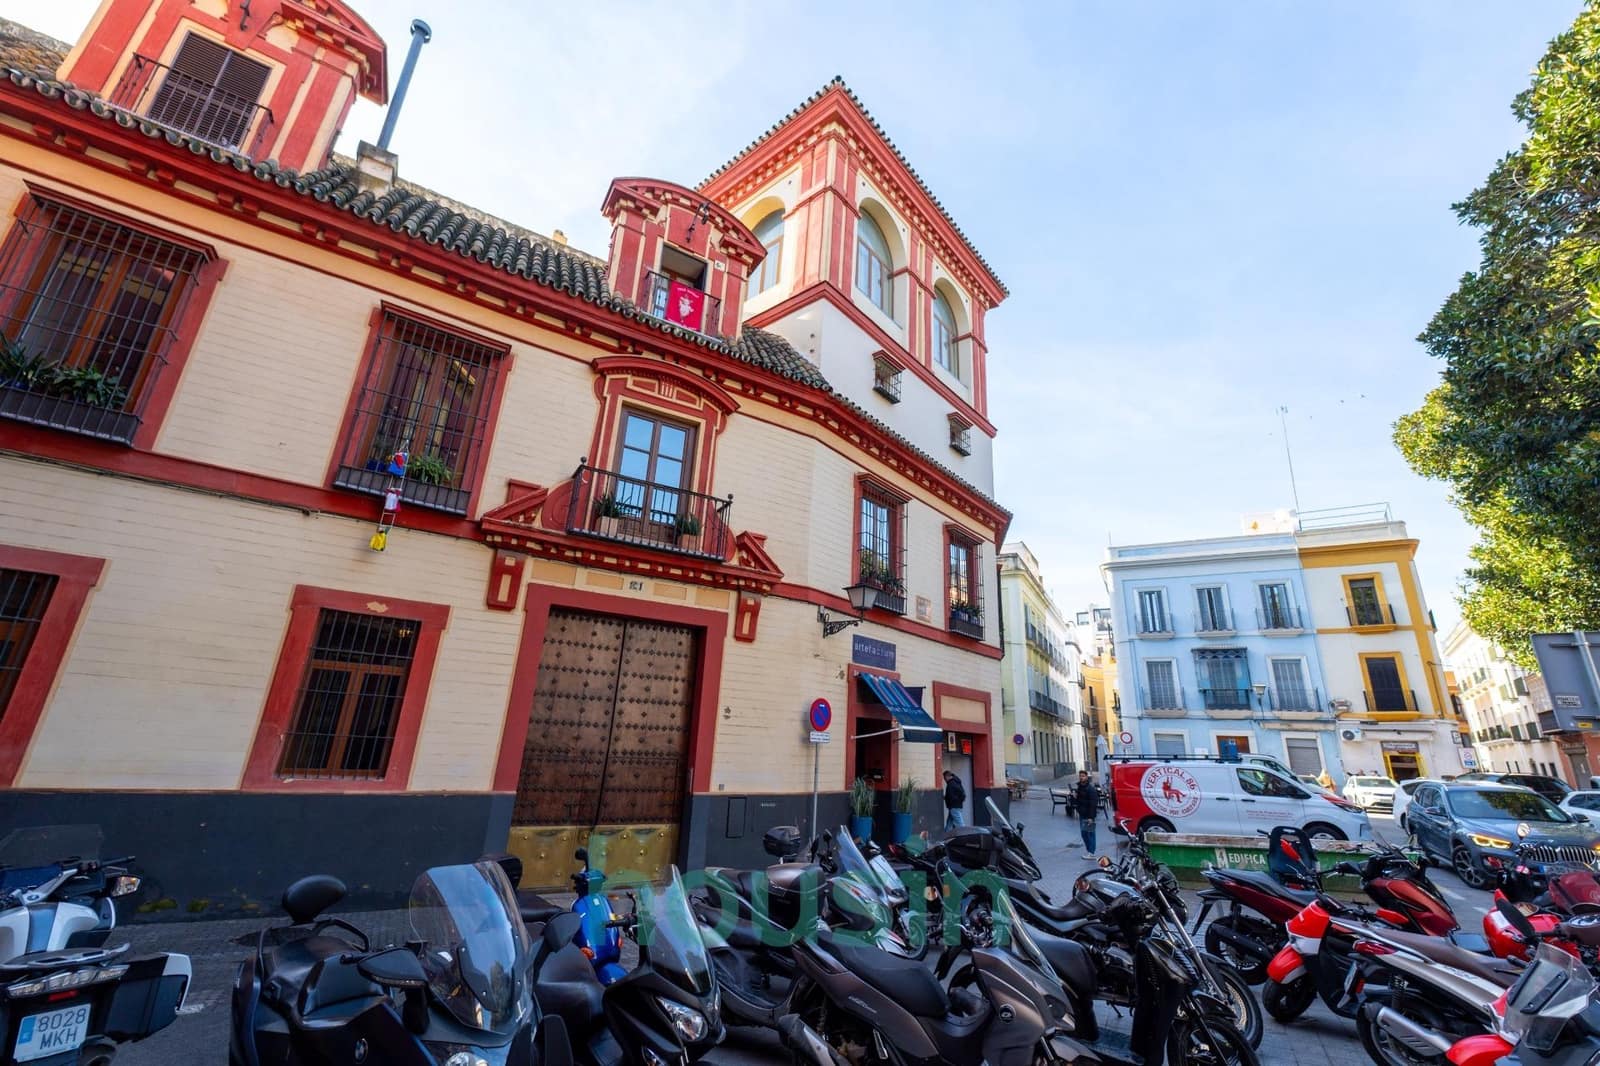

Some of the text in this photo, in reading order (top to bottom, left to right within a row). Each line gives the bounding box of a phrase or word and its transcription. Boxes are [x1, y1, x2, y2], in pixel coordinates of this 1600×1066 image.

[1146, 767, 1185, 789] VERTICAL
[1228, 852, 1266, 864] EDIFICA
[38, 1008, 87, 1032] 8028
[39, 1026, 78, 1050] MKH
